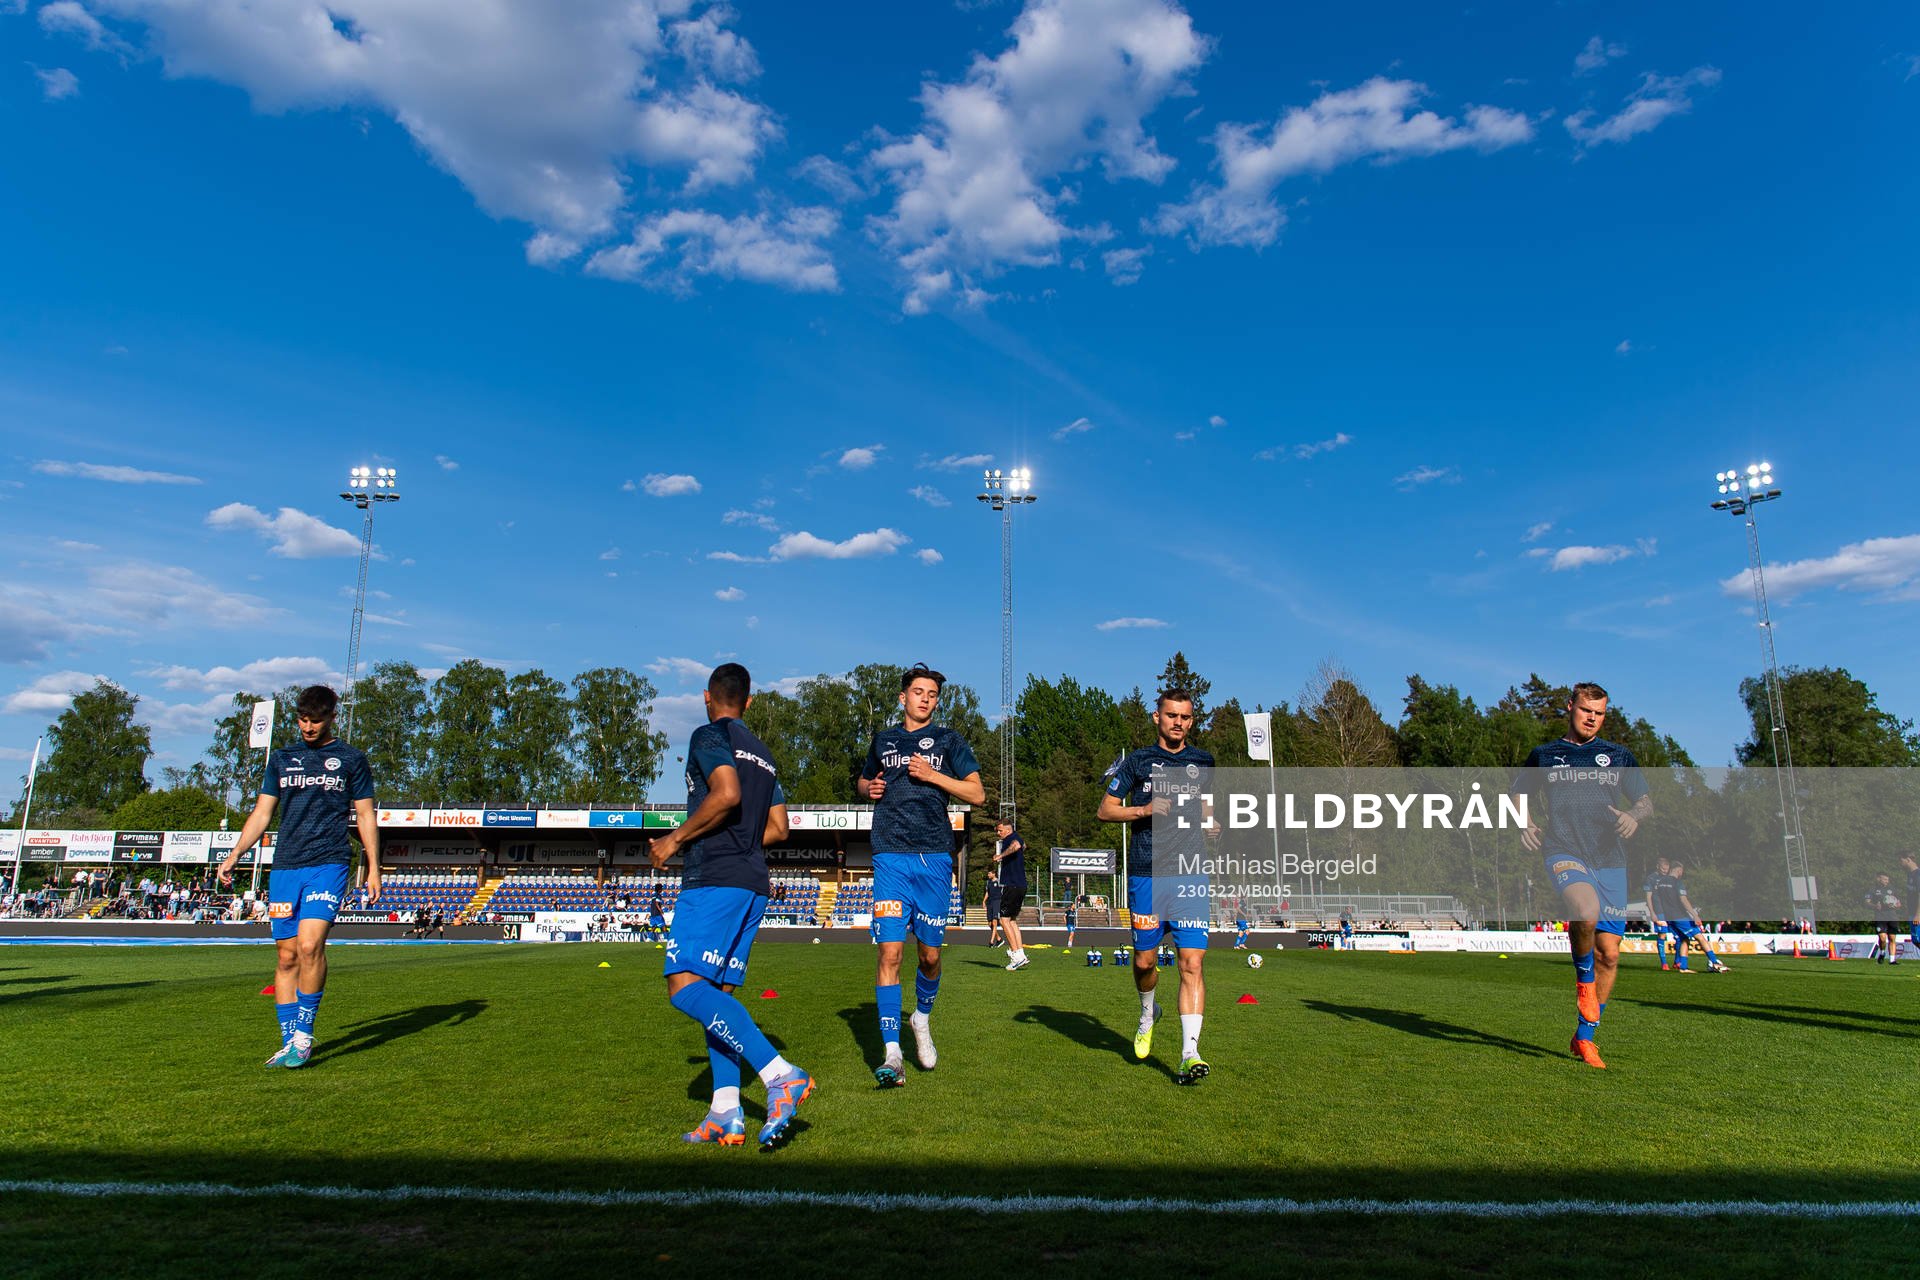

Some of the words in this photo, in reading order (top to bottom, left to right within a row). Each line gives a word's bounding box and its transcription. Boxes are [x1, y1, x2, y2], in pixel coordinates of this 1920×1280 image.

[886, 753, 944, 768] Liljeahl
[1559, 769, 1620, 783] Liljedahl
[218, 833, 233, 842] GLS
[216, 849, 252, 862] golia
[386, 845, 408, 857] 3M
[541, 848, 600, 860] gjuteritekni
[1059, 857, 1107, 866] TROAX
[760, 916, 791, 927] lvabia
[581, 932, 641, 943] ALSVENSKAN
